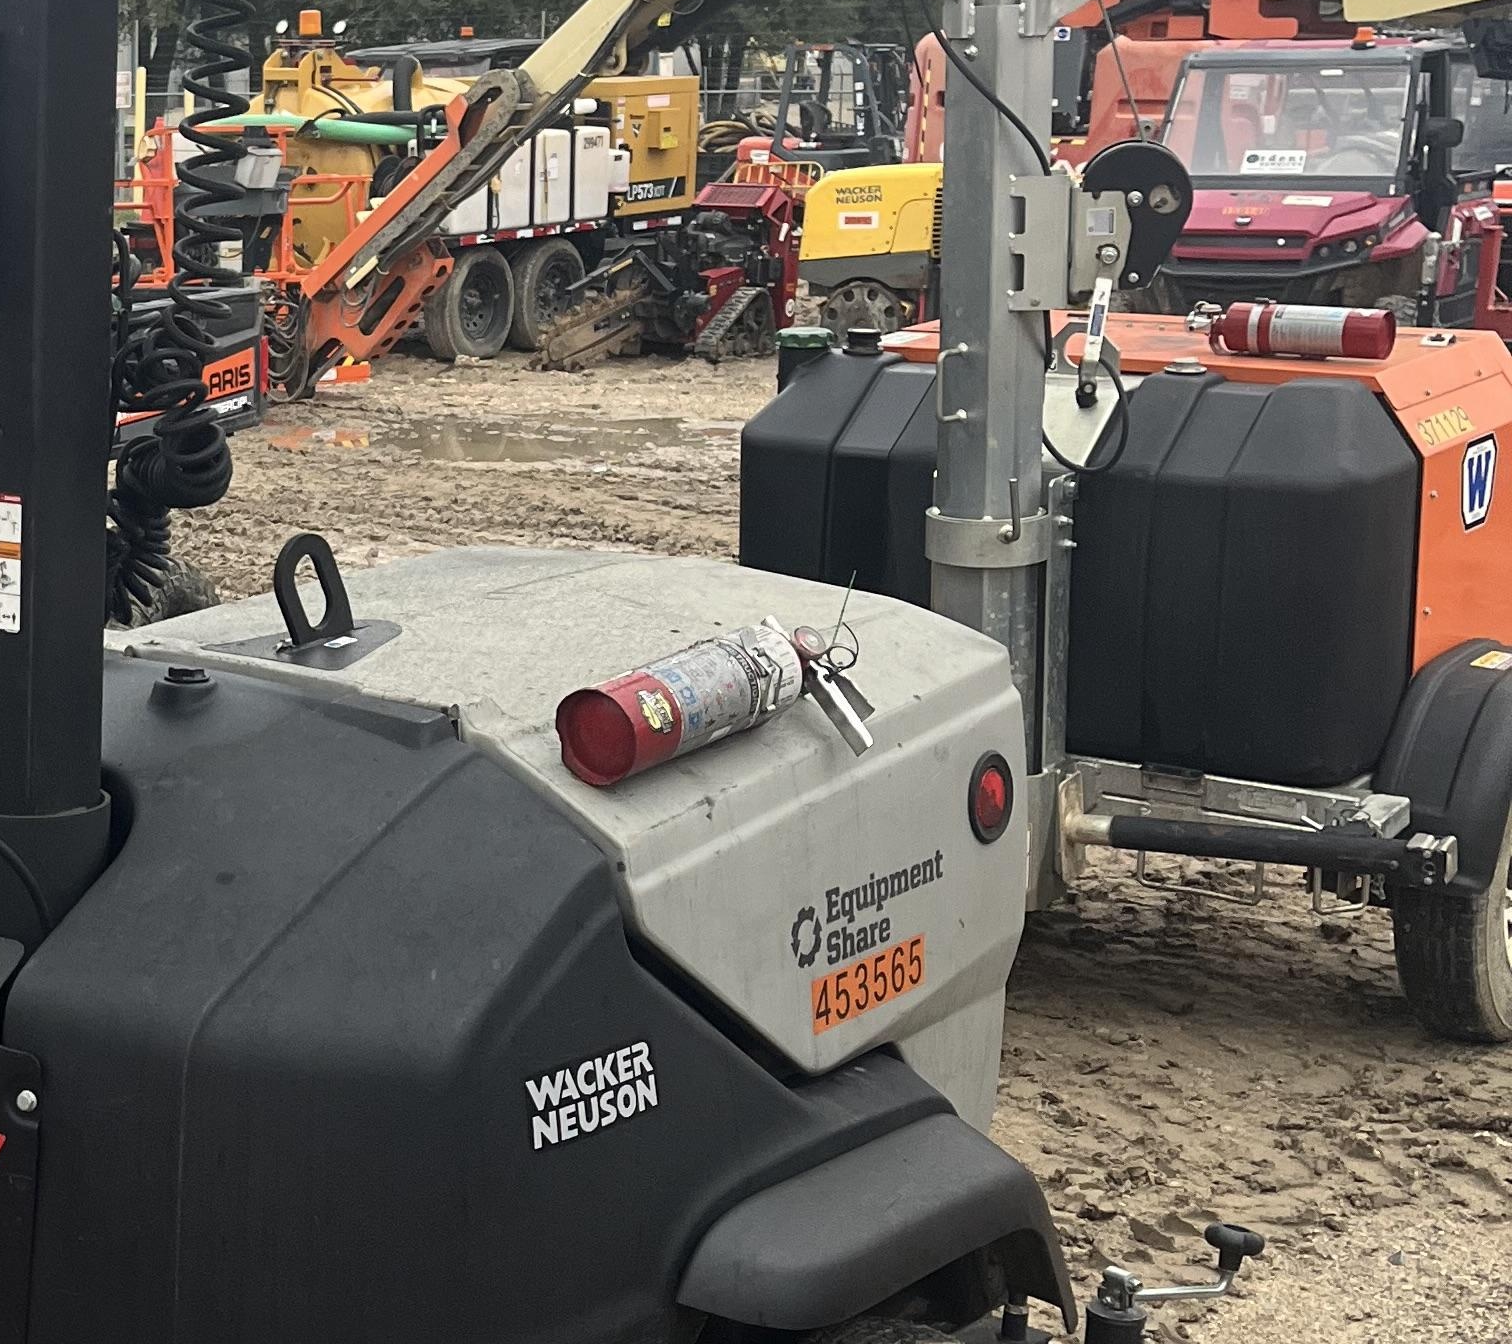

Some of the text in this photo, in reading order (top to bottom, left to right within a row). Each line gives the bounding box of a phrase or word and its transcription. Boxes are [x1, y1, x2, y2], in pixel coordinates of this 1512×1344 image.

[835, 185, 882, 195] WACKER
[836, 194, 883, 205] NEUSON
[209, 363, 251, 395] ARIS
[1467, 450, 1492, 513] W
[825, 849, 944, 925] Equipment
[826, 917, 891, 966] Share
[815, 938, 922, 1026] 453565
[525, 1041, 654, 1112] WACKER
[532, 1072, 658, 1150] NEUSON
